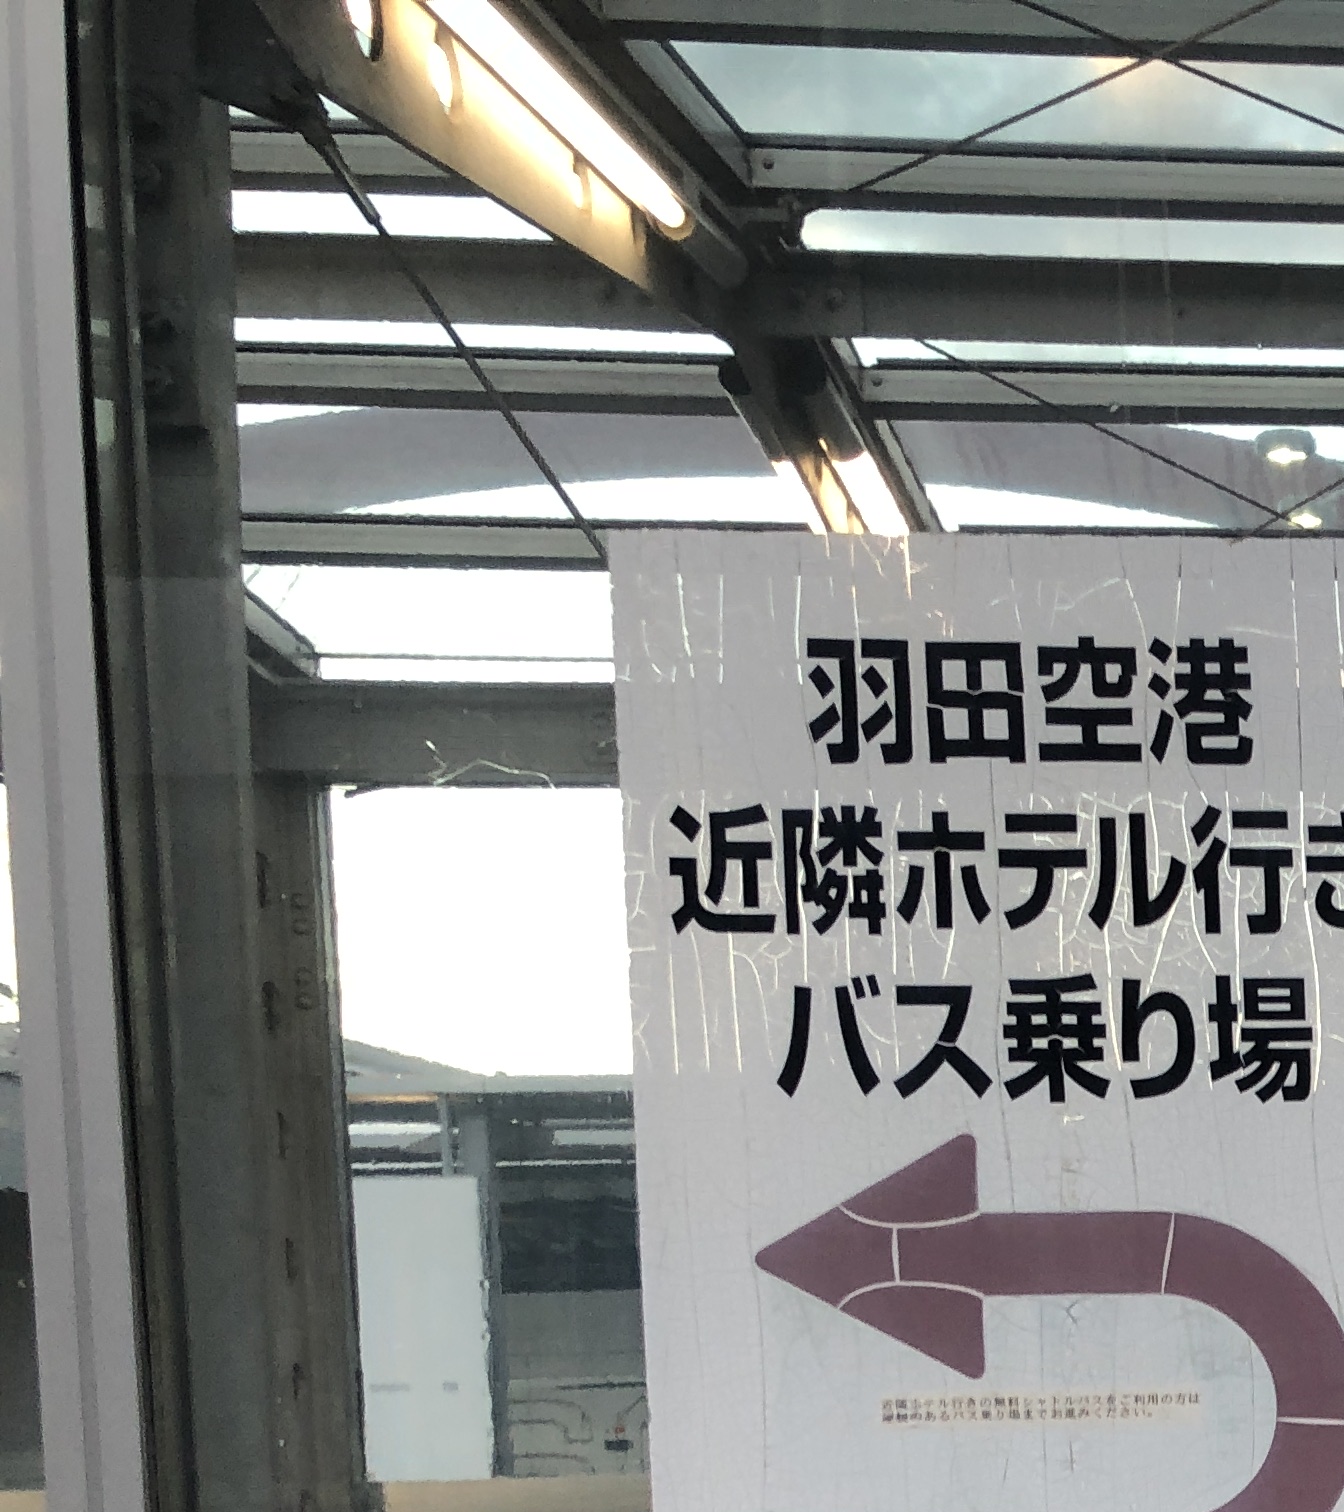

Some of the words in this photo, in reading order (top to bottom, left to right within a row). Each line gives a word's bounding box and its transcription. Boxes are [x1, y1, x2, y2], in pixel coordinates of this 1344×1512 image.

[805, 636, 1255, 766] 羽田空港
[775, 972, 1314, 1104] バス乗り場
